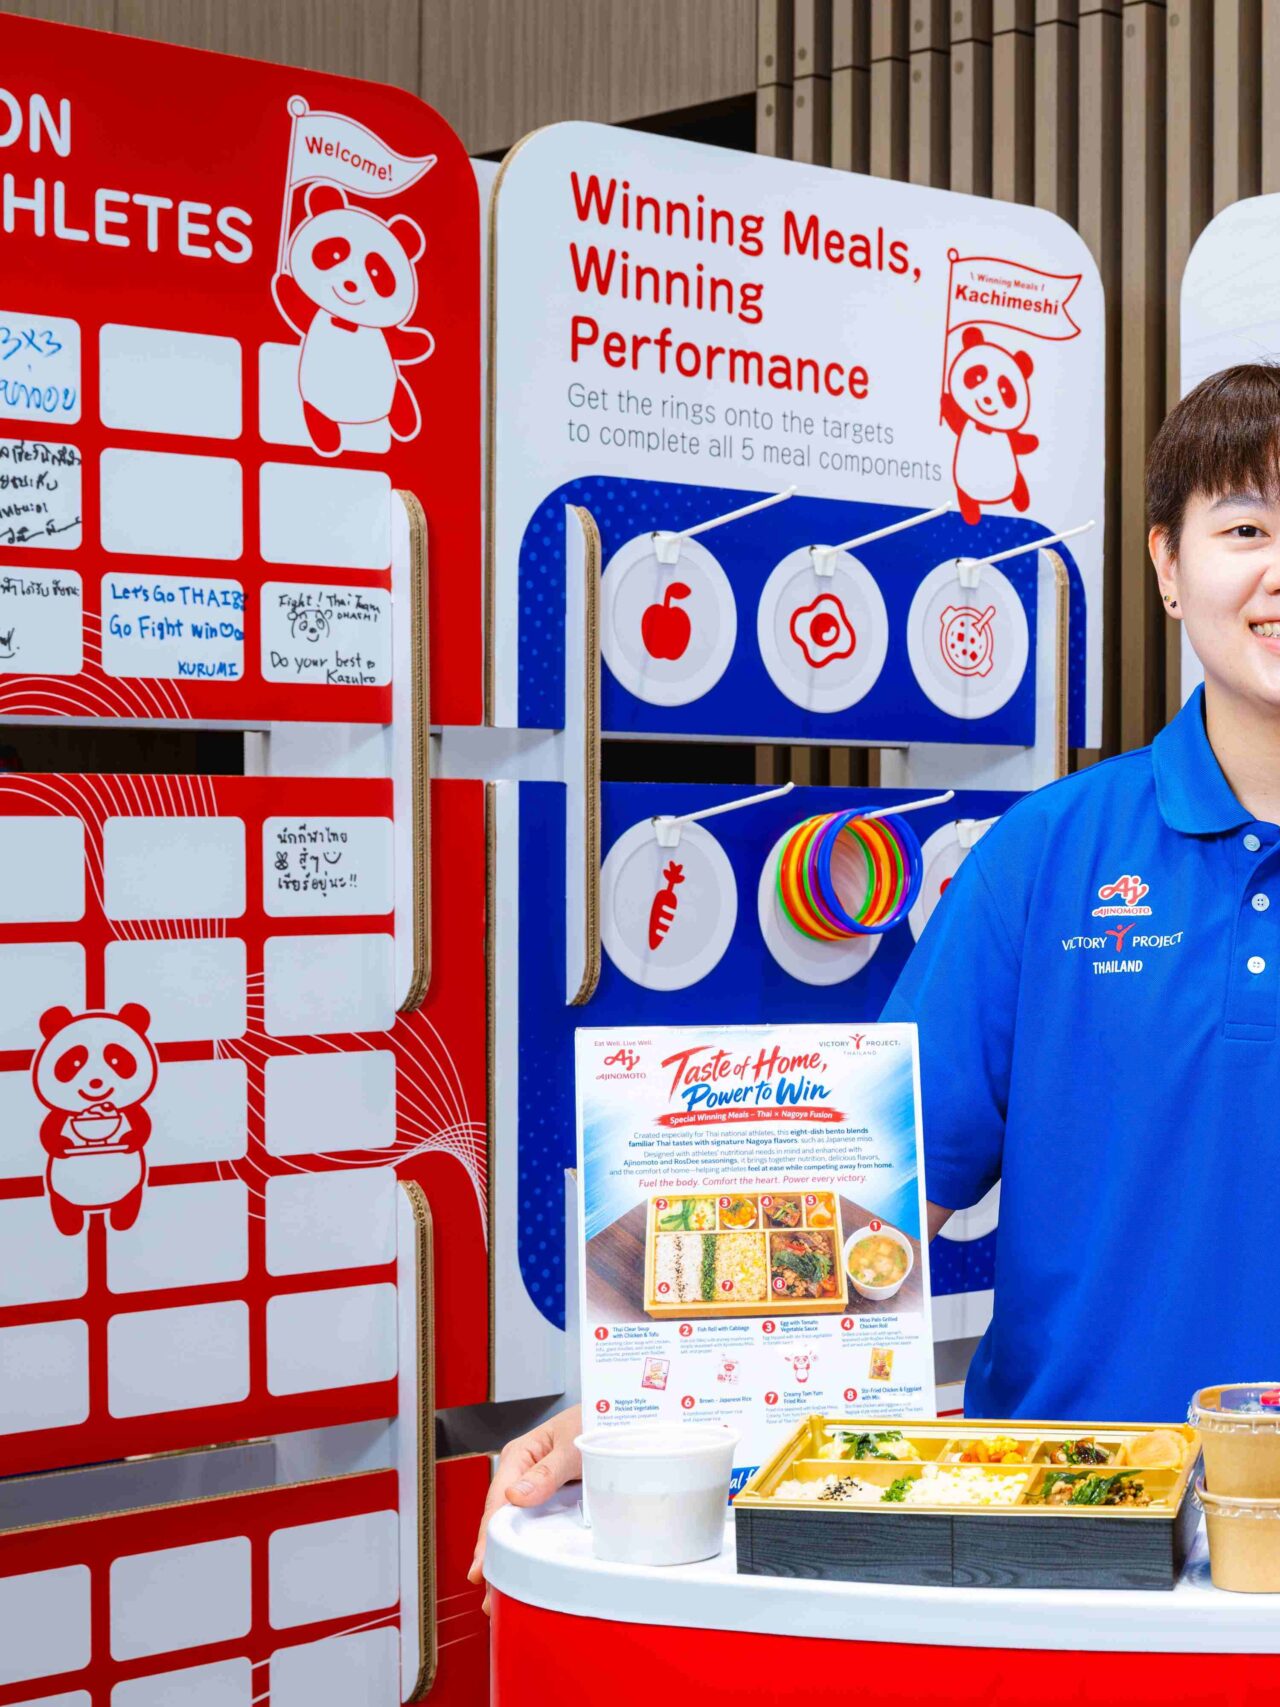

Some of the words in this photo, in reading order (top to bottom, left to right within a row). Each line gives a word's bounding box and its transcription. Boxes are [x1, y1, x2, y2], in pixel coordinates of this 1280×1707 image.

[305, 136, 393, 181] Welcome!
[570, 171, 764, 256] Winning
[783, 210, 922, 283] Meals,
[570, 242, 764, 324] Winning
[955, 284, 1059, 315] Kachimeshi
[570, 315, 869, 399] Performance
[567, 382, 609, 411] Get
[618, 391, 653, 416] the
[661, 395, 716, 425] rings
[725, 405, 773, 430] onto
[782, 411, 814, 435] the
[823, 416, 894, 444] targets
[567, 419, 590, 442] to
[599, 426, 700, 455] complete
[709, 435, 733, 459] all
[741, 438, 754, 461] 5
[763, 445, 811, 467] meal
[819, 450, 942, 482] components
[153, 585, 176, 603] Go
[327, 593, 352, 607] Thai
[110, 614, 132, 638] Go
[138, 615, 183, 640] Fight
[178, 661, 238, 677] KURUMI
[271, 651, 289, 668] Do
[295, 657, 327, 674] your
[336, 650, 362, 667] best
[277, 824, 348, 844] นักกีฬาไทย
[1093, 907, 1151, 917] AJINOMOTO
[1062, 936, 1107, 951] VICTORY
[1132, 931, 1184, 948] PROJECT
[1093, 960, 1143, 974] THAILAND
[596, 1072, 646, 1080] AJINOMOTO
[660, 1045, 732, 1104] Taste
[734, 1055, 752, 1080] of
[752, 1045, 828, 1082] Home,
[681, 1080, 755, 1111] Power
[755, 1080, 773, 1104] to
[775, 1076, 833, 1105] Win
[670, 1115, 696, 1125] Special
[697, 1112, 727, 1123] Winning
[728, 1110, 749, 1120] Meals
[757, 1110, 773, 1118] Thai
[781, 1110, 808, 1120] Nagoya
[809, 1110, 833, 1119] Fusion
[638, 1179, 657, 1187] Fuel
[659, 1178, 674, 1186] the
[702, 1176, 737, 1186] Comfort
[739, 1176, 753, 1185] the
[783, 1175, 809, 1184] Power
[811, 1175, 835, 1184] every
